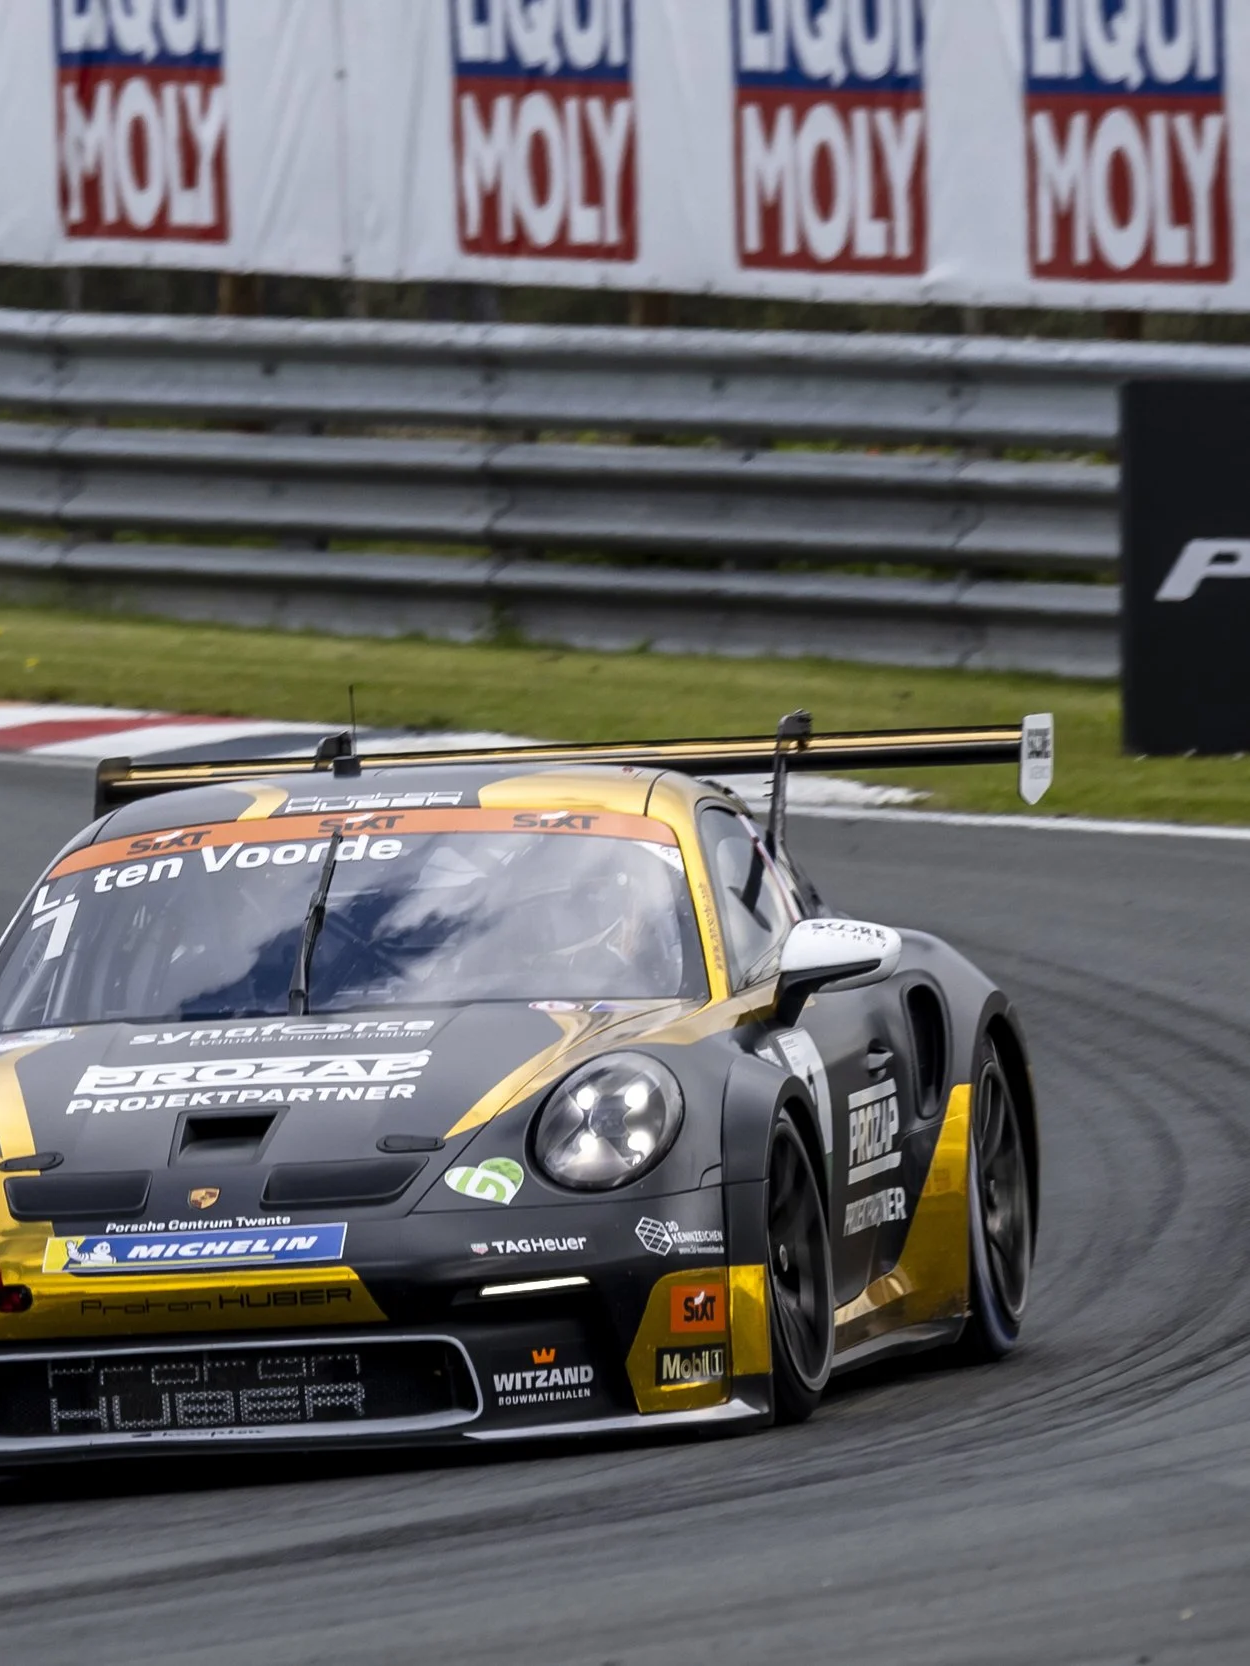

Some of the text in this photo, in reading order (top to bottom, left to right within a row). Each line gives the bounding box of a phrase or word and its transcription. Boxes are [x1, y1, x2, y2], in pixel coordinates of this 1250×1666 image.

[62, 79, 228, 229] MOLY
[460, 92, 634, 246] MOLY
[740, 103, 924, 261] MOLY
[1031, 108, 1225, 269] MOLY
[94, 857, 183, 894] ten
[201, 834, 403, 874] Voorde
[31, 898, 81, 962] 1
[65, 1084, 417, 1115] PROJEKTPARTNER
[105, 1215, 292, 1234] Porsche Centrum Twente
[126, 1235, 319, 1260] MICHELIN
[493, 1365, 594, 1392] WITZAND
[662, 1352, 709, 1381] Mobil
[50, 1381, 366, 1433] HUBER
[498, 1388, 591, 1406] BOUWMATERIALEN
